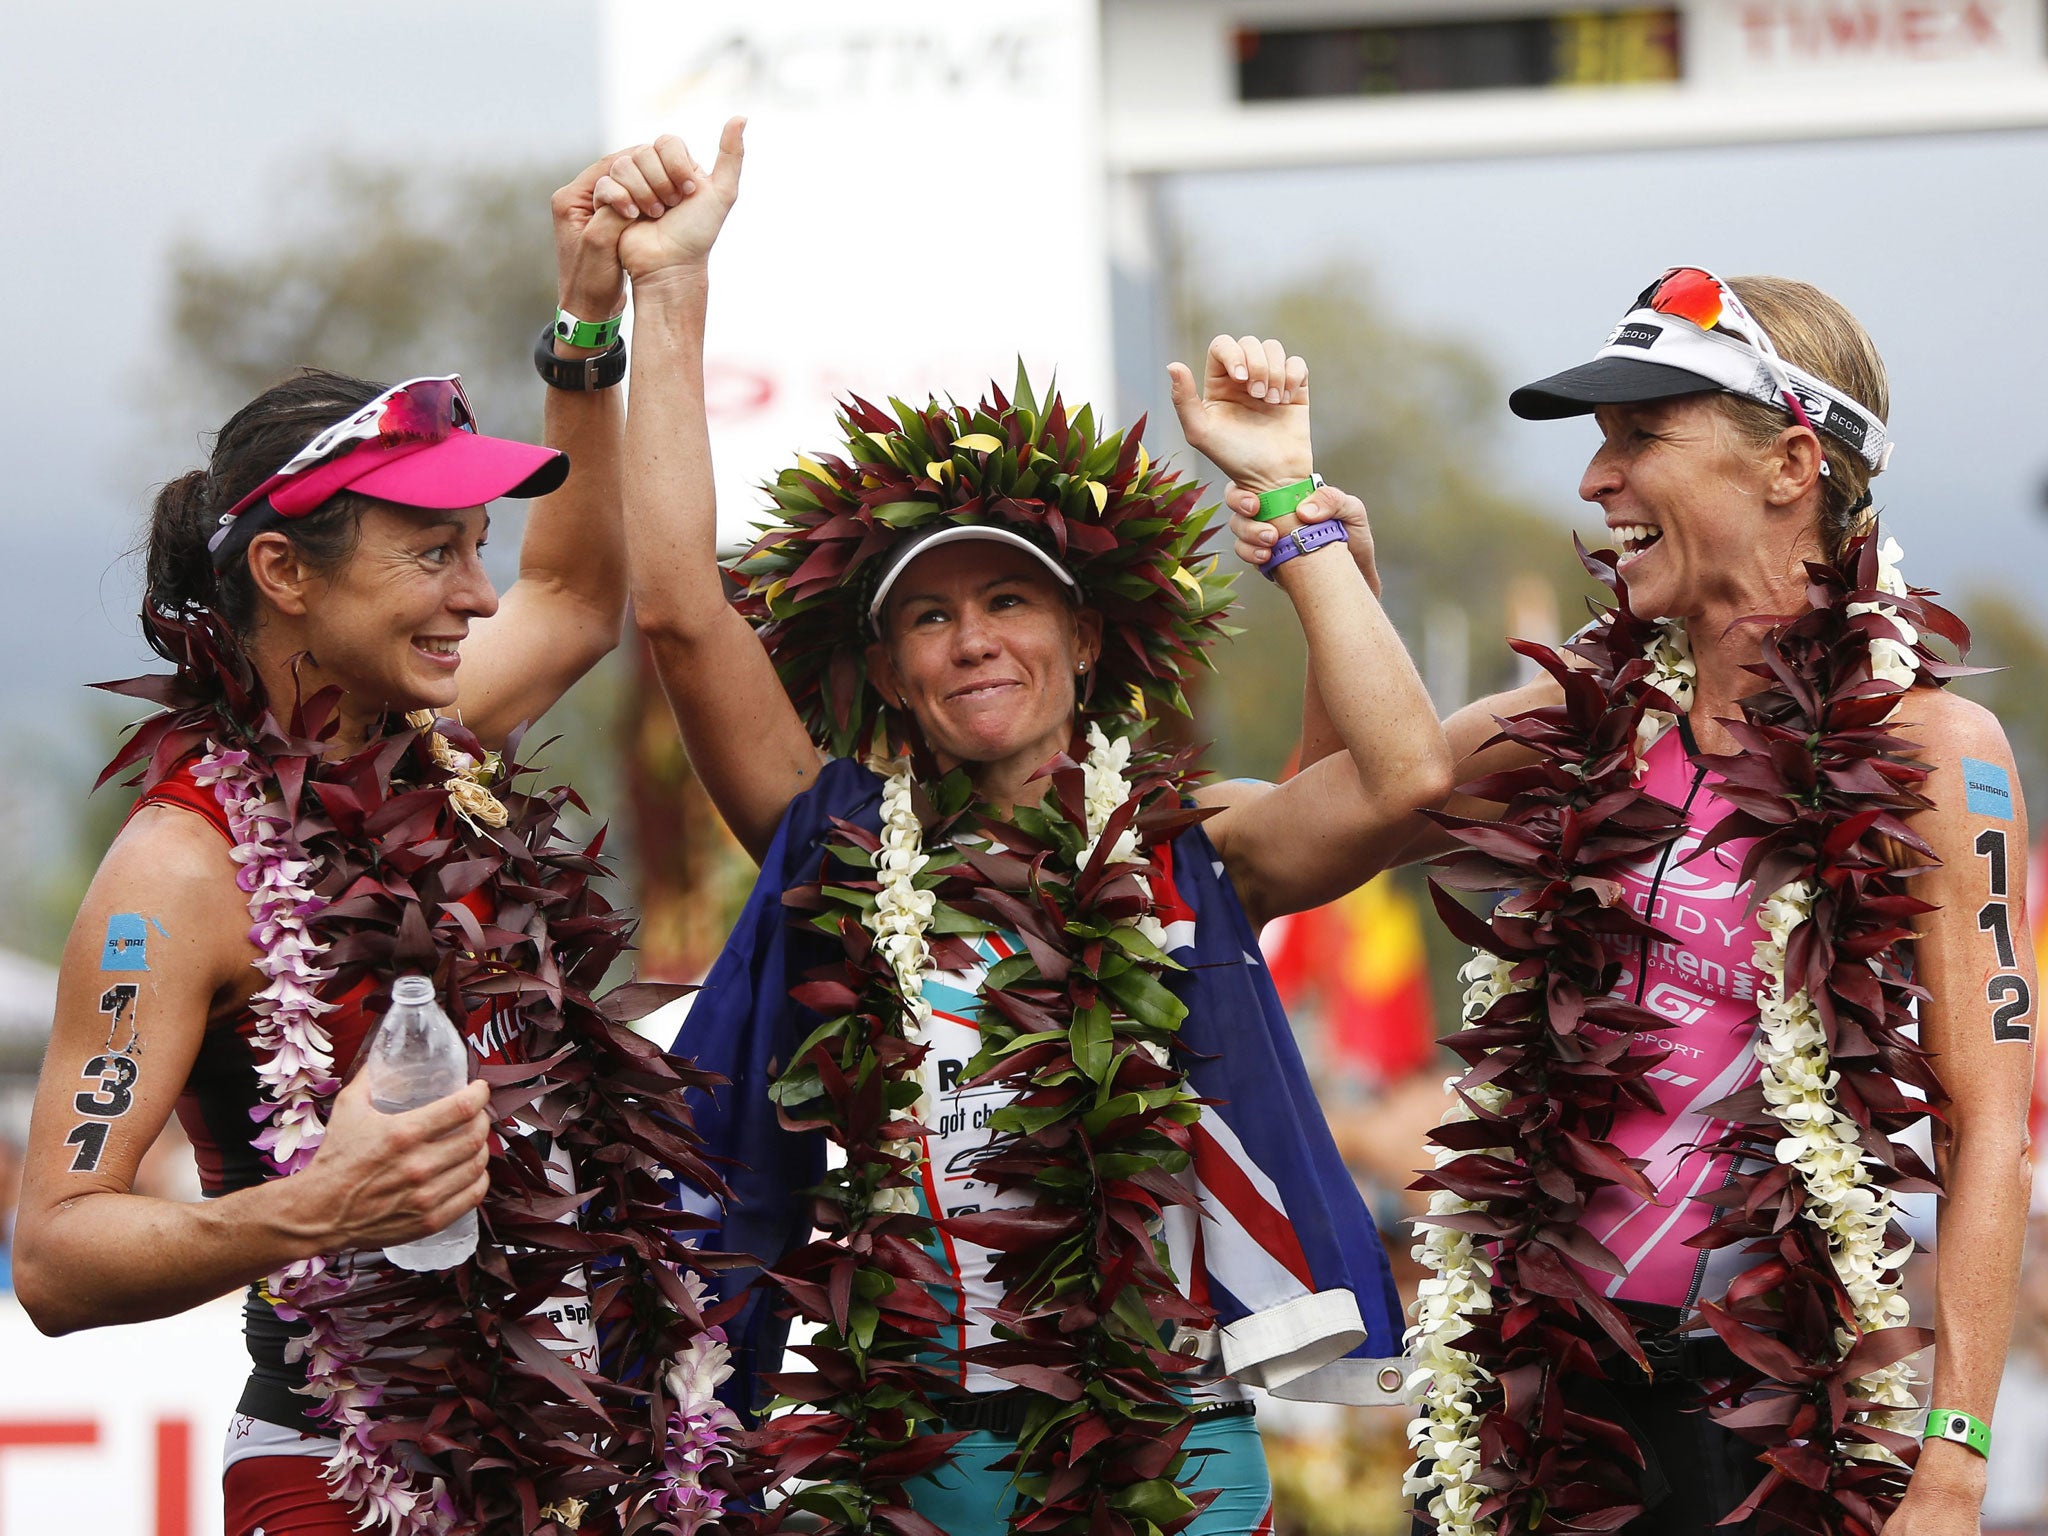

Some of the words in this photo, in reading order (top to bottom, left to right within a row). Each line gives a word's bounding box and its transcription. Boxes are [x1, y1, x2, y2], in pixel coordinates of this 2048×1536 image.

[1740, 0, 2004, 61] TIMEX
[1830, 411, 1865, 437] SCODY
[1969, 781, 2009, 798] SHIMANO
[1973, 827, 2032, 1043] 112
[1633, 954, 1727, 996] SOFTWARE
[63, 982, 140, 1173] 131
[940, 1107, 966, 1139] got
